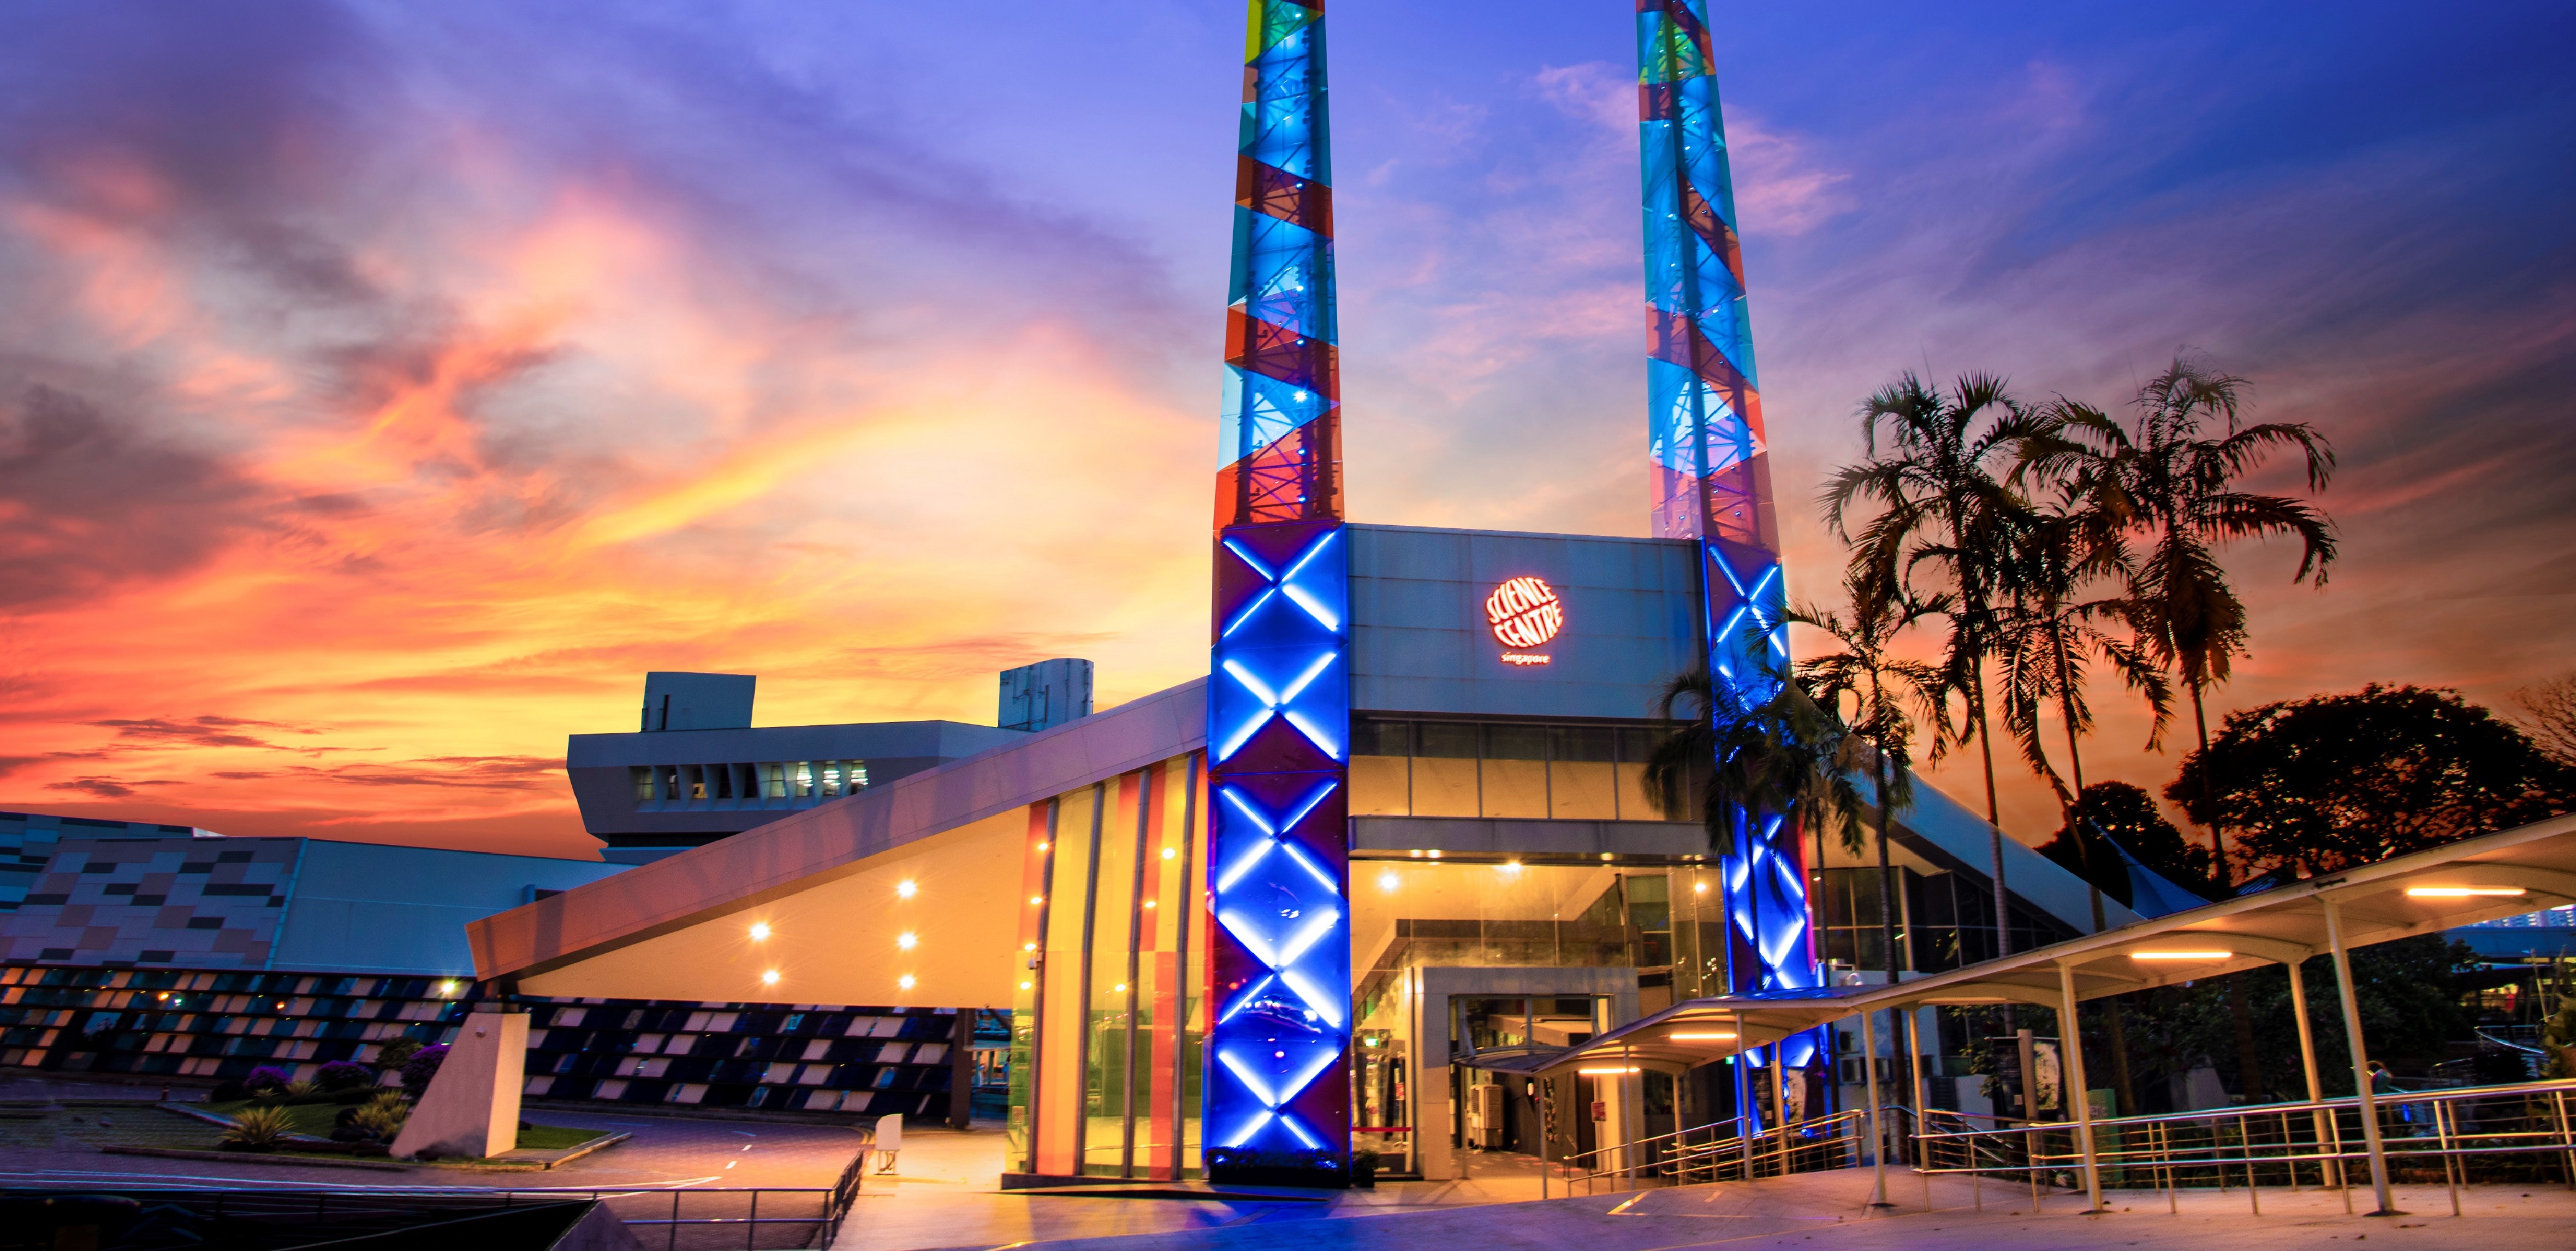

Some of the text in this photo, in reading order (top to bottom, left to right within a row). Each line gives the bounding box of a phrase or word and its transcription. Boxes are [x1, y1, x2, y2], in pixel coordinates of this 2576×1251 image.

[1486, 577, 1556, 624] SCIENCE
[1494, 599, 1564, 647] CENTRE
[1501, 652, 1550, 665] singapore
